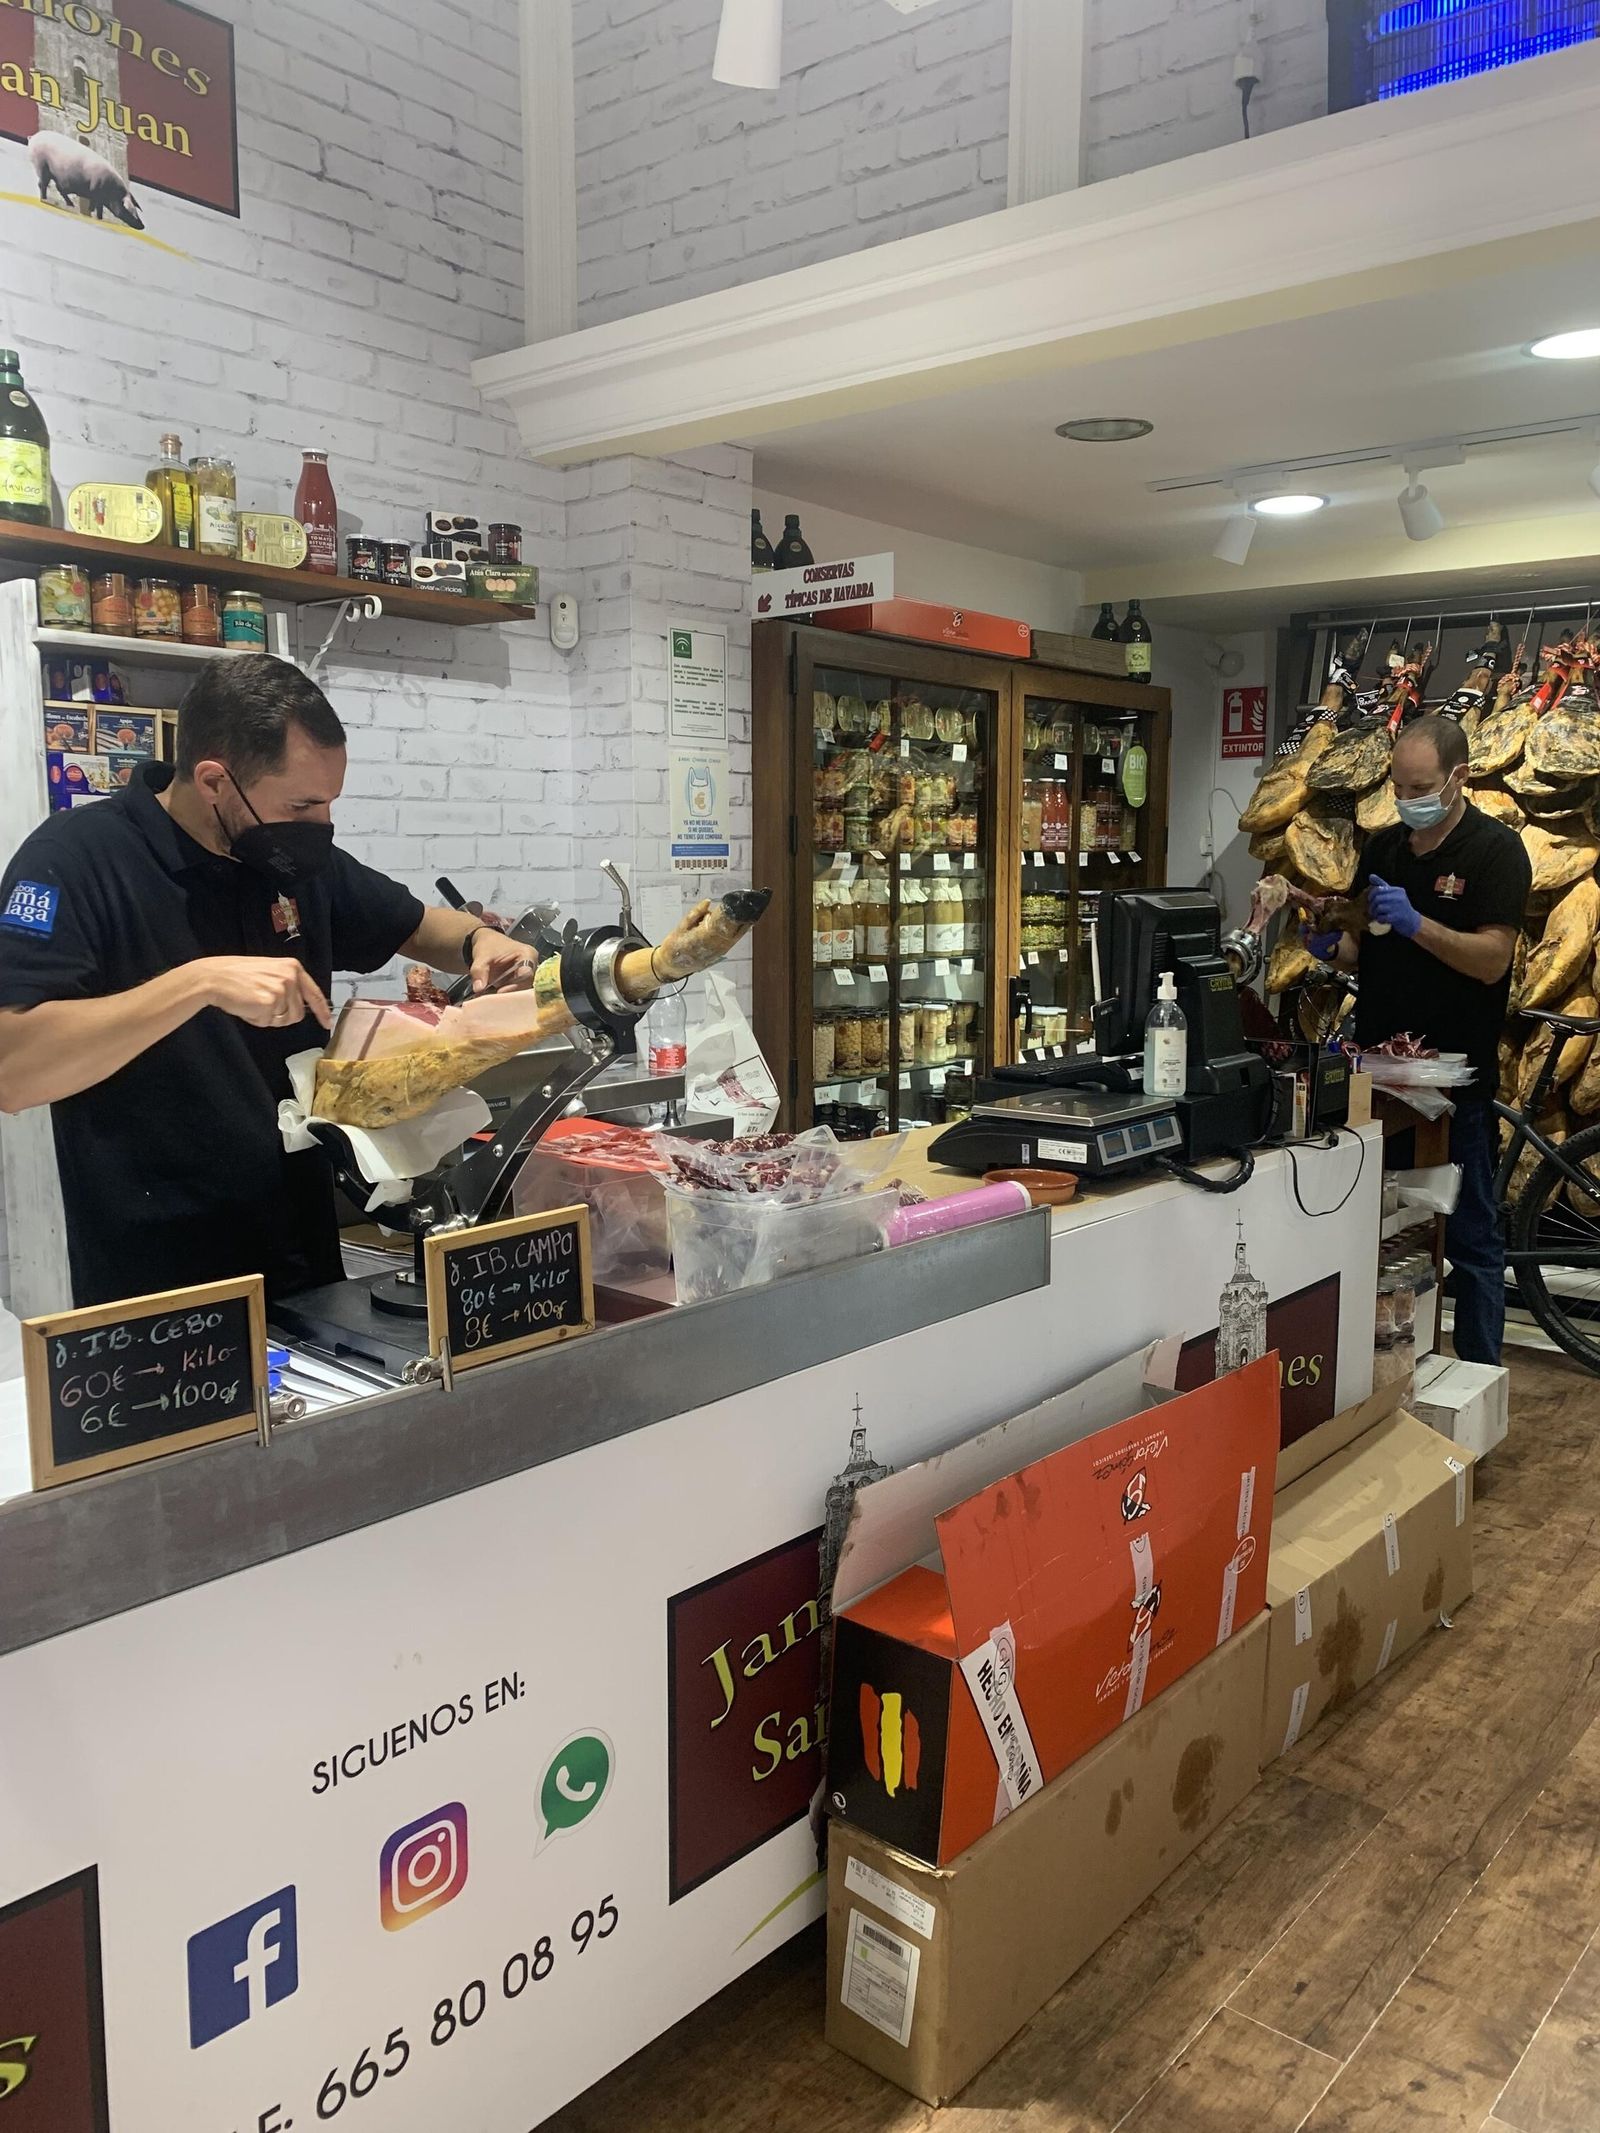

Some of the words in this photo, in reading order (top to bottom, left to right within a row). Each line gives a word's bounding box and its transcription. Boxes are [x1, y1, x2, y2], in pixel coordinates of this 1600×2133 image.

[76, 76, 193, 158] Juan
[803, 561, 855, 584] CONSERVAS
[785, 588, 818, 609] TÍPICAS
[819, 587, 833, 604] DE
[833, 581, 875, 603] NAVARRA
[1129, 753, 1146, 770] BIO
[1222, 742, 1265, 754] EXTINTOR
[514, 1229, 573, 1269] CAMPO
[460, 1283, 497, 1317] 80€
[149, 1312, 224, 1346] CEBO
[464, 1313, 494, 1349] 8€
[59, 1364, 129, 1408] 60€
[80, 1401, 129, 1434] 6€
[977, 1658, 1007, 1722] HECHO
[311, 1693, 474, 1795] SIGUENOS
[484, 1670, 526, 1715] EN:
[315, 2026, 410, 2121] 665
[430, 1979, 486, 2047] 80
[502, 1935, 555, 2000] 08
[570, 1893, 620, 1956] 95
